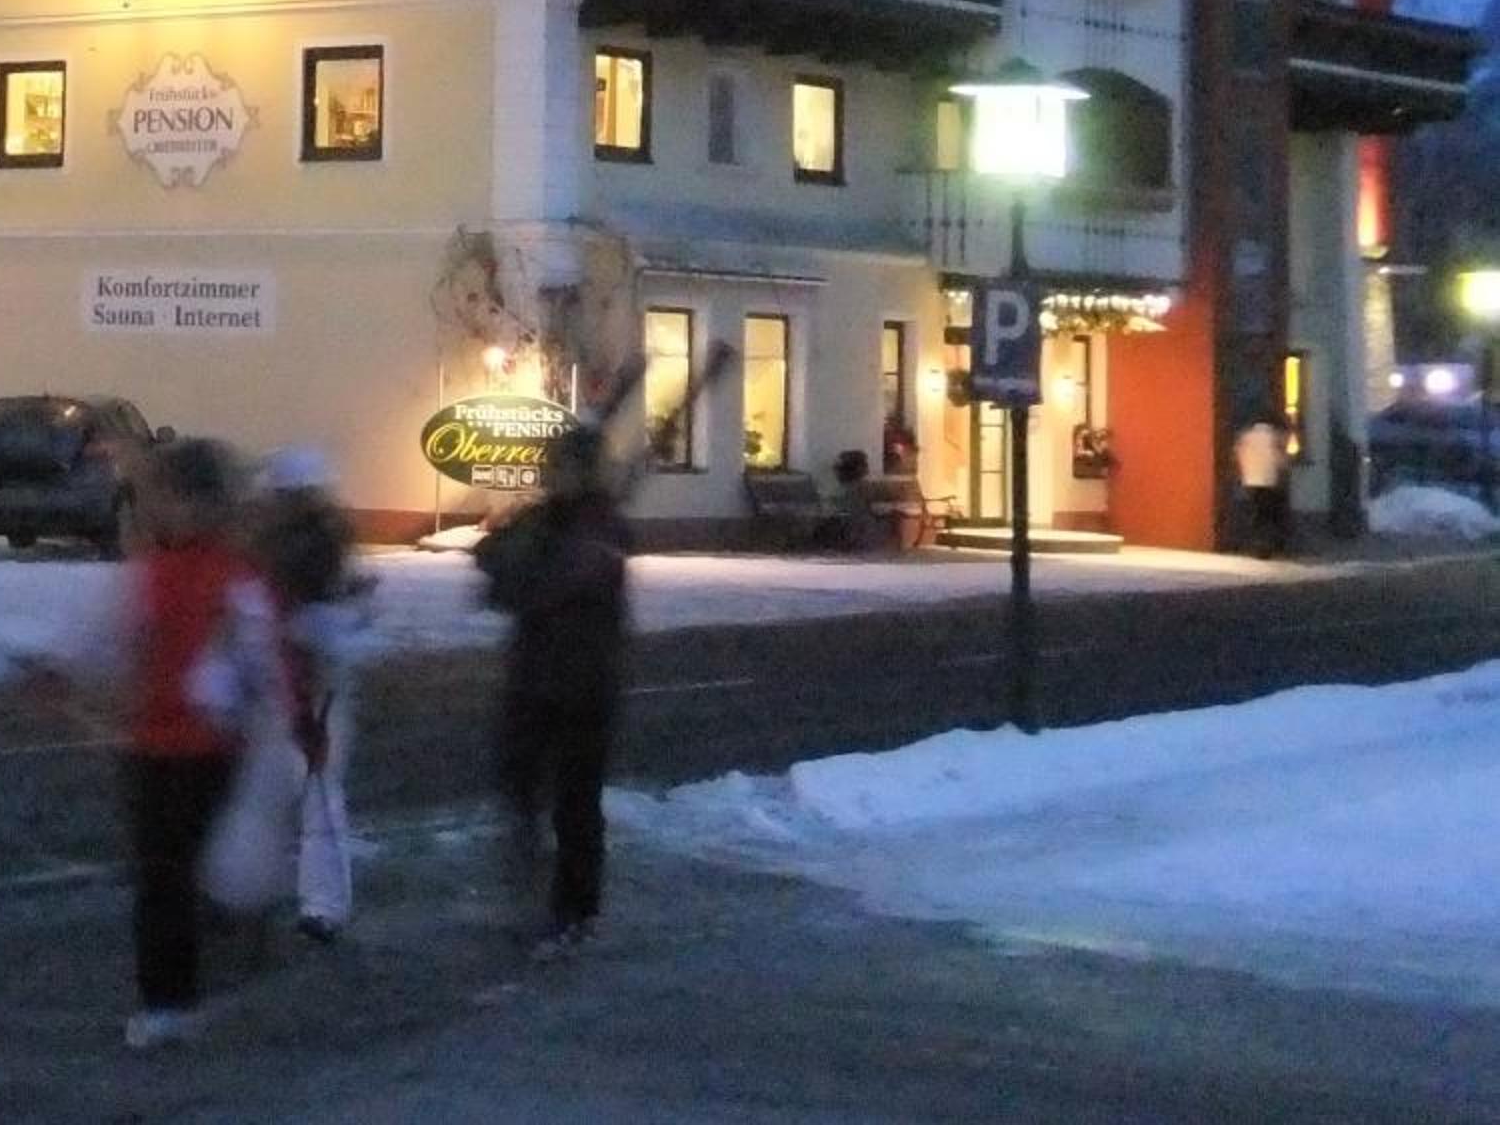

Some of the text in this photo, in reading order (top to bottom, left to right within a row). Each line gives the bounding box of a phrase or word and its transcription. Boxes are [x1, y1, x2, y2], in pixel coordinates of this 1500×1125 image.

[133, 106, 232, 133] PENSION
[98, 276, 260, 298] Komfortzimmer
[93, 303, 260, 327] Sauna Internet
[985, 290, 1029, 365] P
